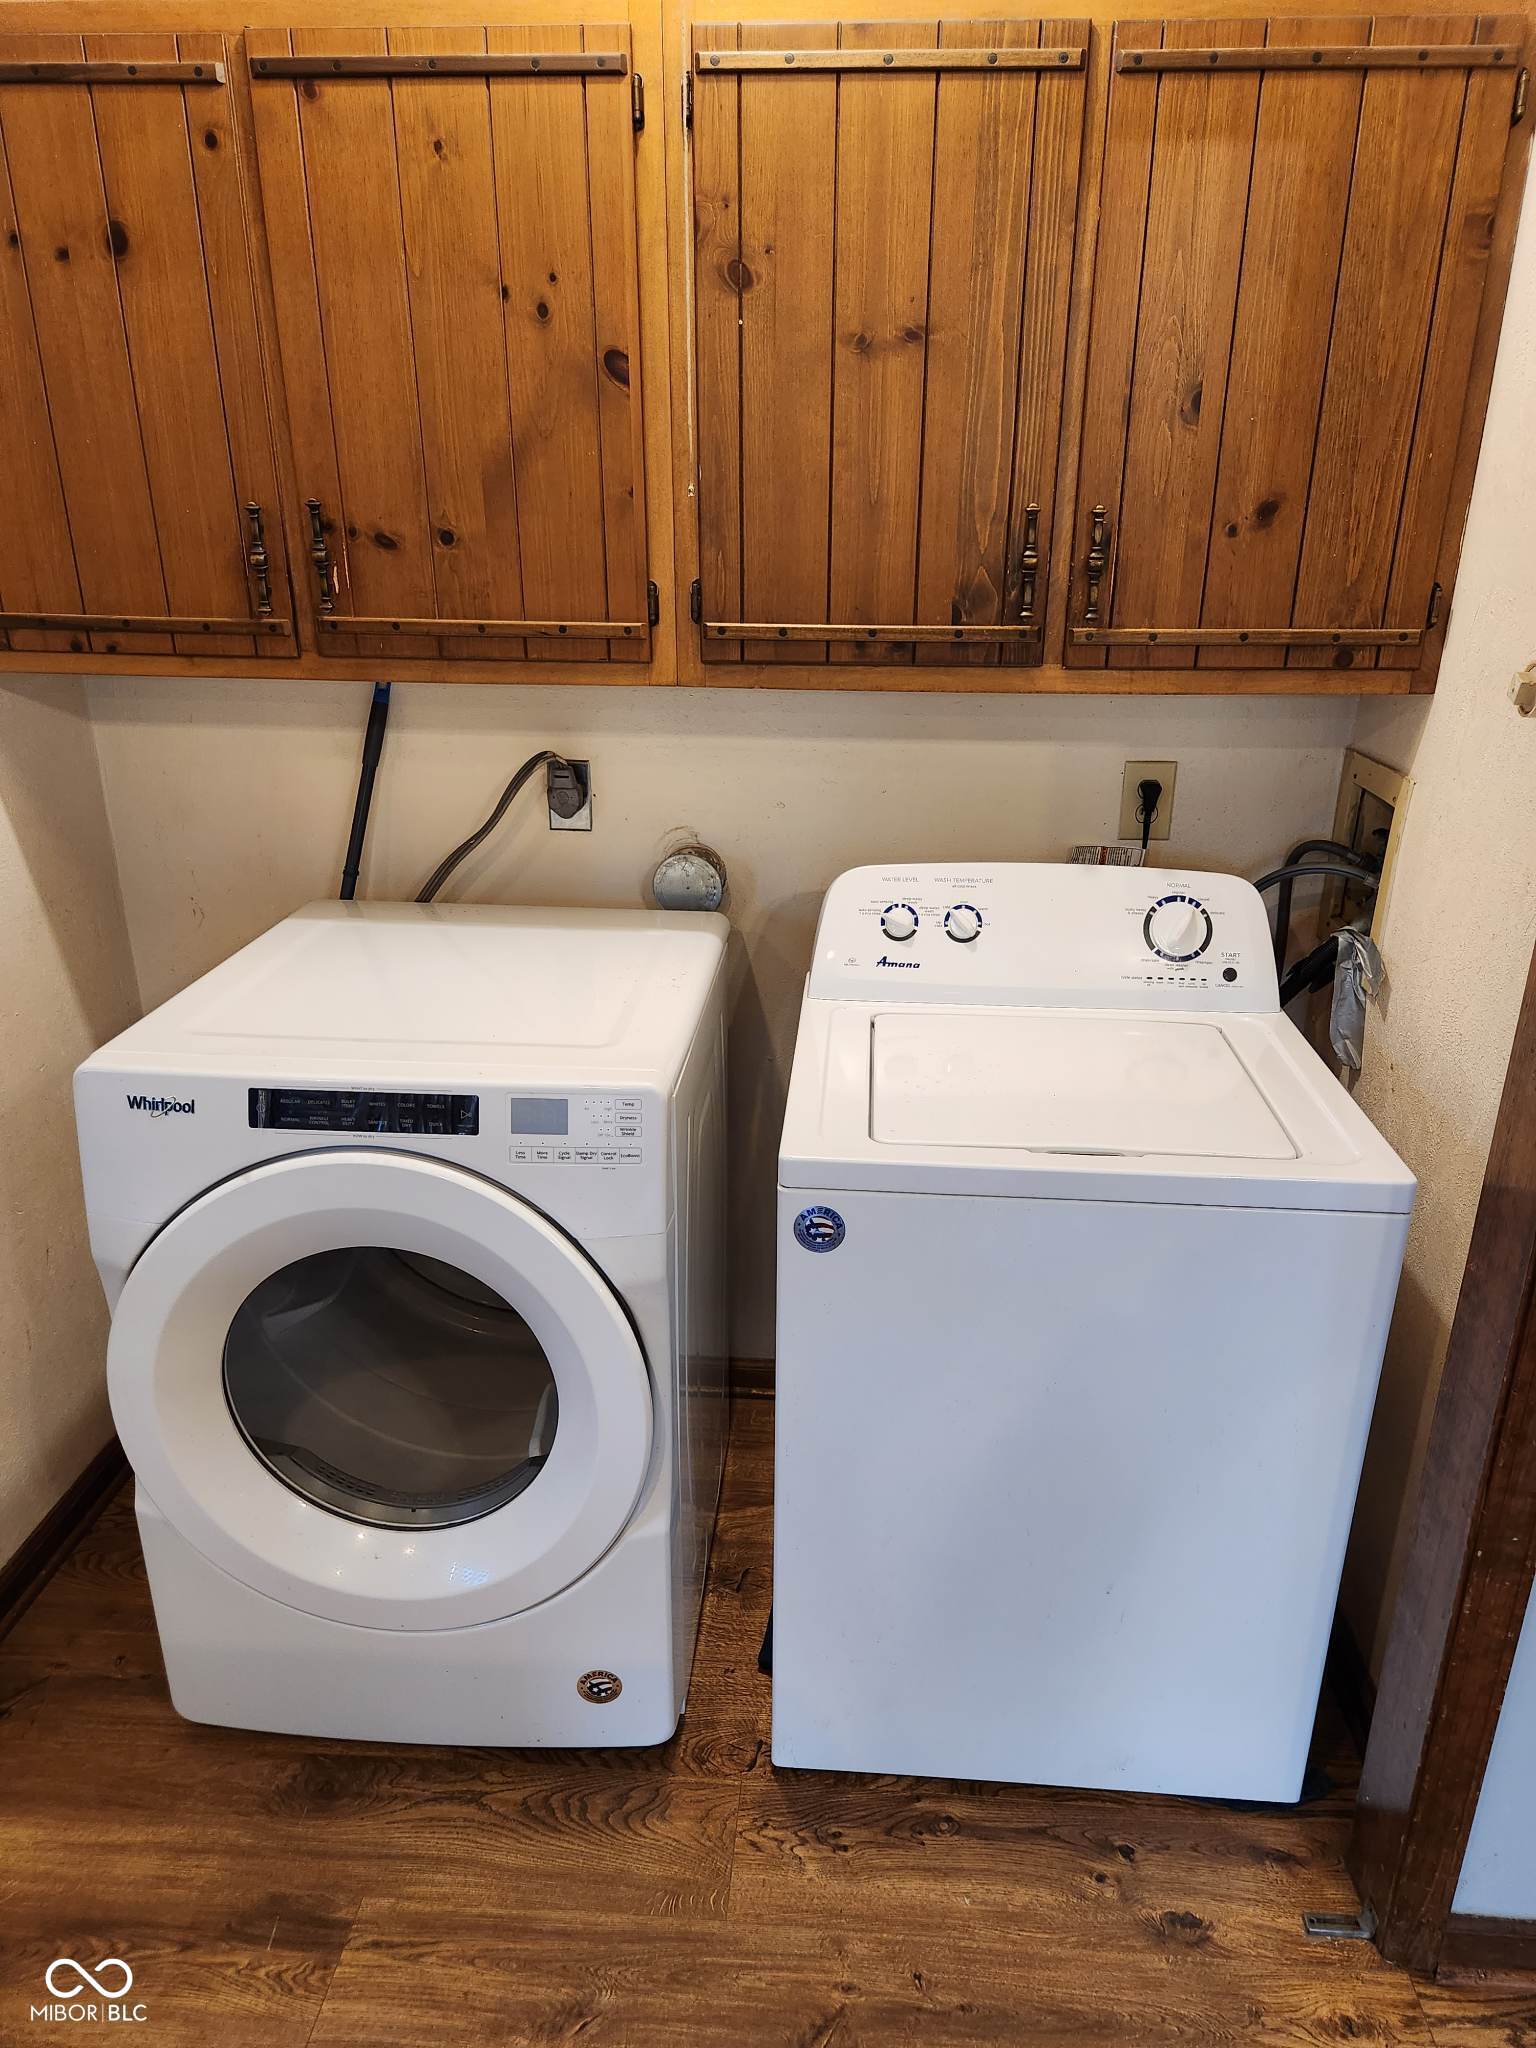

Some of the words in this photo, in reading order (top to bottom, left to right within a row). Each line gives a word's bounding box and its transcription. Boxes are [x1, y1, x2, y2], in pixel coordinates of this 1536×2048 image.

[876, 956, 921, 969] Amana
[127, 1095, 195, 1117] Whirlpool
[800, 1207, 843, 1230] AMERICA
[580, 1671, 618, 1686] AMERICA
